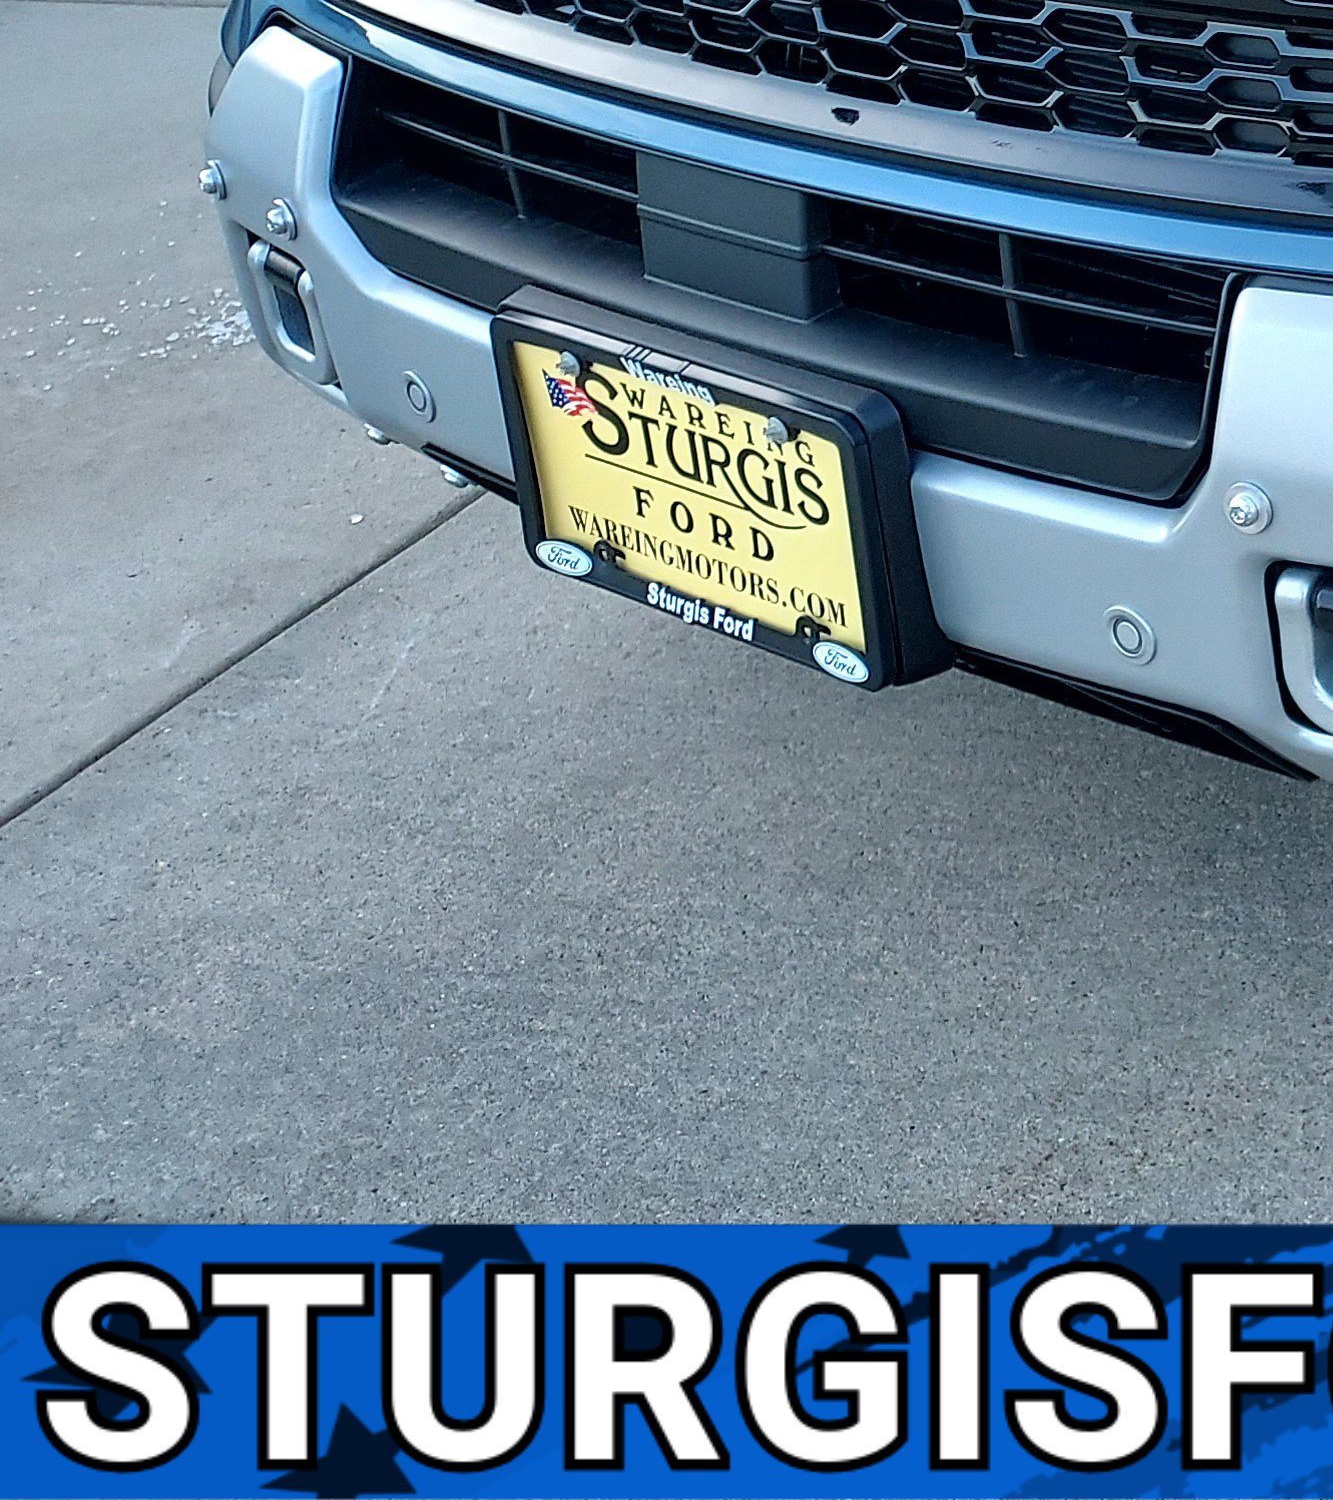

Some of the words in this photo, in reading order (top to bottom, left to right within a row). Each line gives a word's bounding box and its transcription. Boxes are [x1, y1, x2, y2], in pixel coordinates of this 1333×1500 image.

[620, 357, 717, 407] Wareing
[575, 363, 830, 529] STURGIS
[633, 486, 775, 563] FORD
[568, 505, 849, 628] WAREINGMOTORS.COM
[647, 581, 711, 626] Sturgis
[713, 607, 755, 642] Ford
